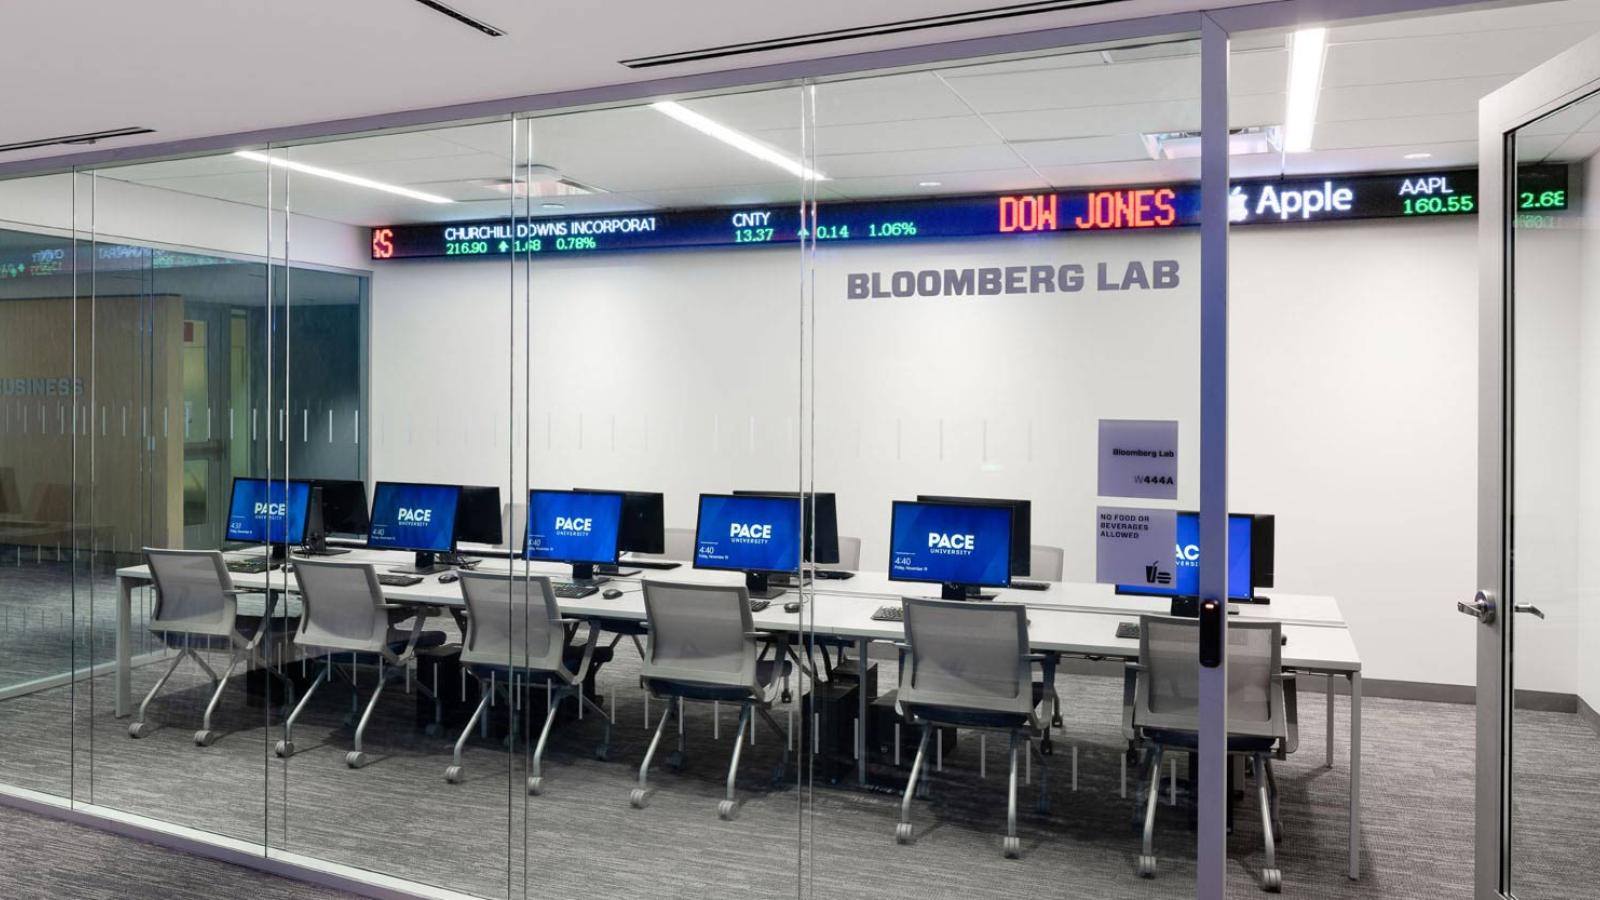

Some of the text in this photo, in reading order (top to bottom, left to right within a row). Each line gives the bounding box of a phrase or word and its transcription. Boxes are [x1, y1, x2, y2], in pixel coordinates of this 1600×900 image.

[1399, 177, 1453, 195] AAPL
[1255, 181, 1353, 219] Apple
[1403, 195, 1474, 215] 160.55
[999, 188, 1176, 232] DOW JONES
[732, 211, 771, 227] CNTY
[444, 225, 512, 241] CHURCHILL
[516, 222, 567, 236] DOWNS
[735, 222, 916, 242] 13.37 0.14 1.06%
[446, 241, 487, 254] 216.90
[556, 237, 596, 250] 0.78%
[847, 260, 1180, 300] BLOOMBERG LAB
[1112, 448, 1157, 458] Bloomberg
[1134, 475, 1173, 485] W444A
[254, 502, 286, 516] PACE
[398, 508, 431, 521] PACE
[555, 517, 592, 531] PACE
[1100, 513, 1112, 521] NO
[1114, 514, 1136, 522] FOOD
[730, 523, 772, 539] PACE
[1100, 522, 1149, 530] BEVERAGES
[928, 532, 975, 550] PACE
[1100, 530, 1140, 539] ALLOWED
[929, 548, 972, 556] UNIVERSITY
[1176, 544, 1200, 560] AC
